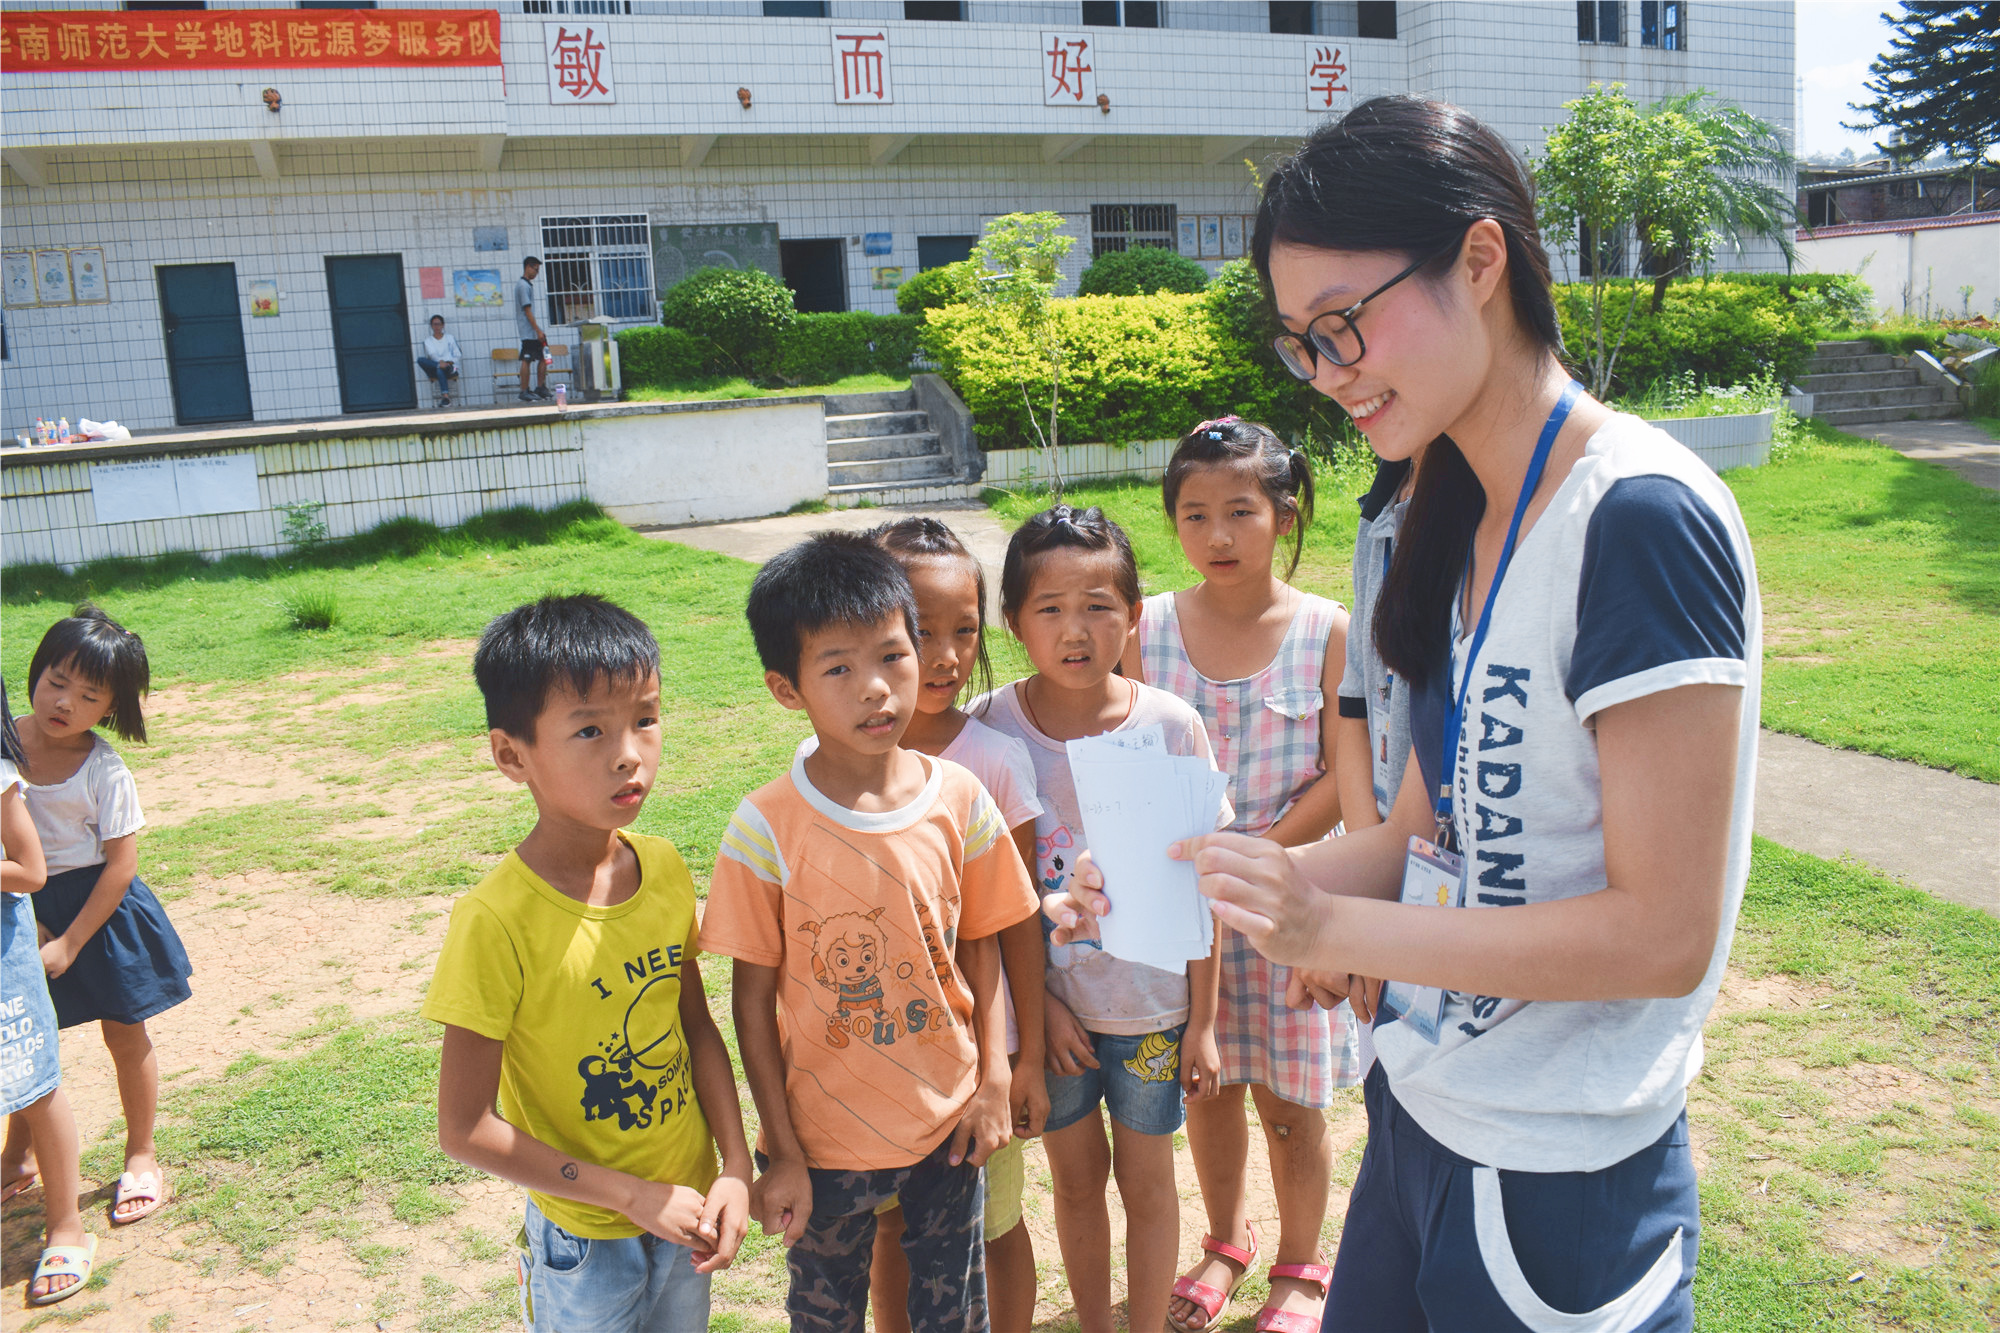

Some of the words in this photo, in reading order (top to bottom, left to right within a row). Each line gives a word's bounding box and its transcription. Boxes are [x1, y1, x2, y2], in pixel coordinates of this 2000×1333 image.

[551, 26, 610, 99] 敏
[835, 31, 885, 100] 而
[1046, 36, 1092, 102] 好
[1309, 46, 1349, 108] 学
[590, 977, 613, 1000] I
